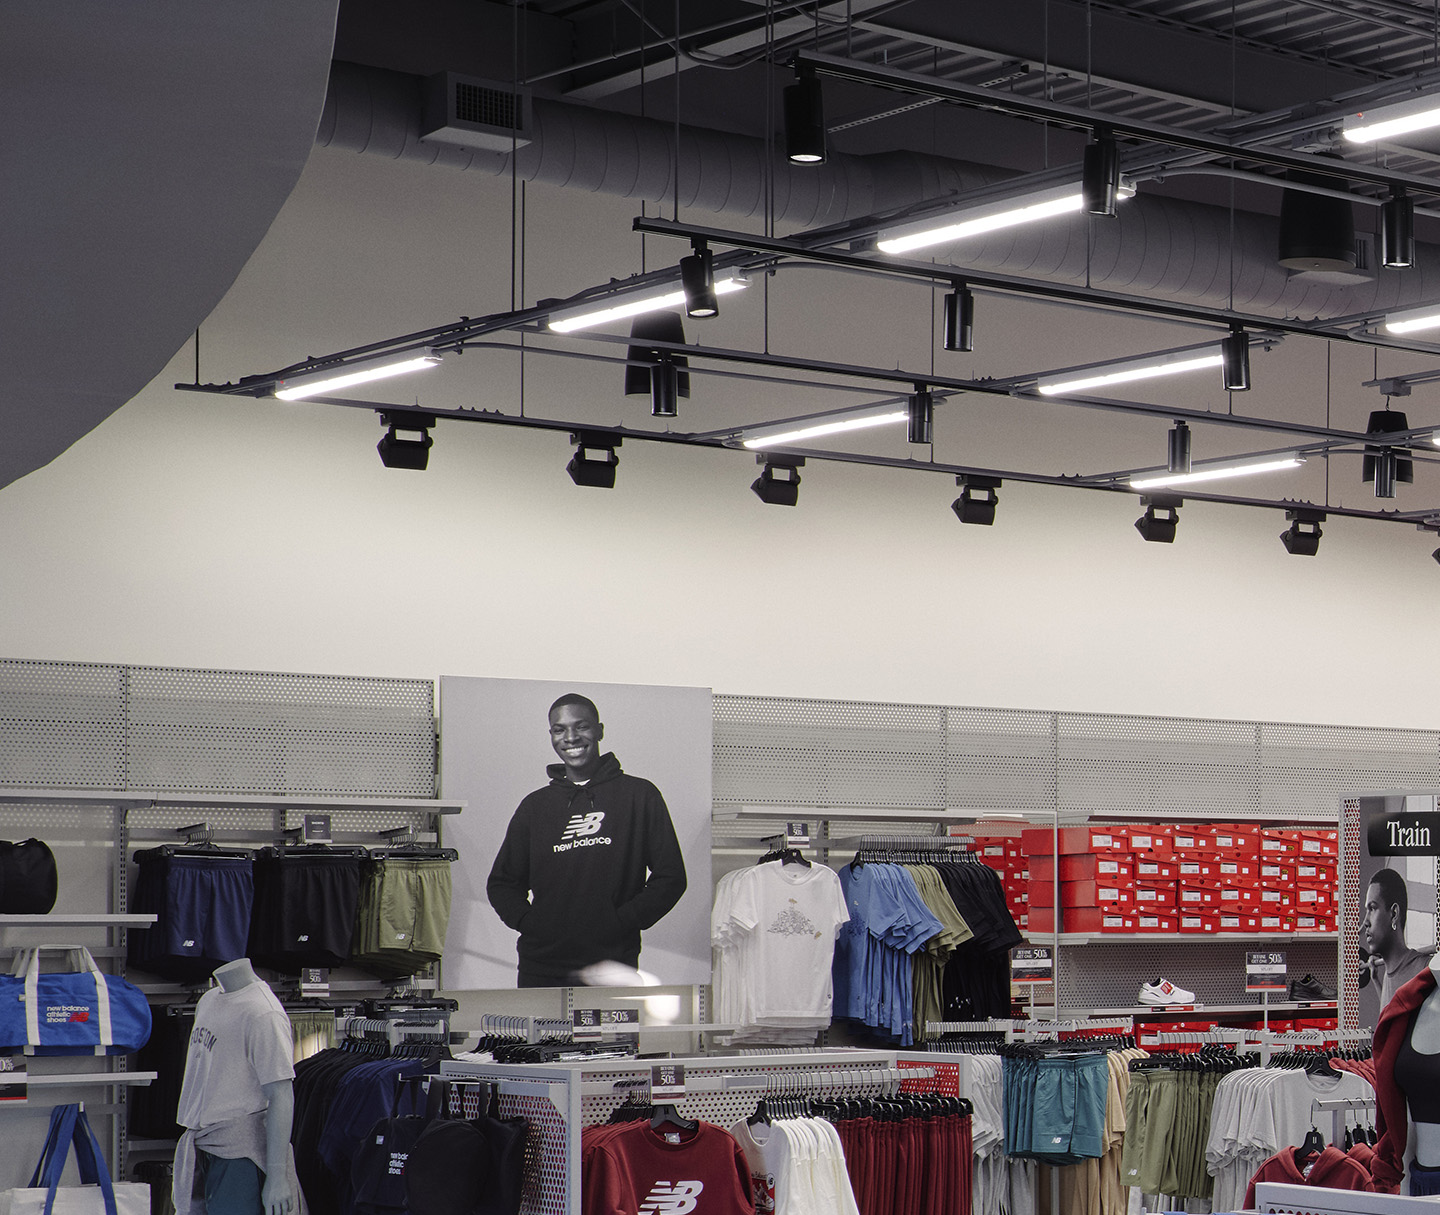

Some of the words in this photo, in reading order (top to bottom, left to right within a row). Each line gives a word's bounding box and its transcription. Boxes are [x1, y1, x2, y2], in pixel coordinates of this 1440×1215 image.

[560, 811, 606, 840] NB
[1387, 820, 1432, 848] Train
[552, 842, 573, 852] new
[573, 836, 612, 848] balance
[1268, 953, 1282, 964] 50%
[660, 1074, 675, 1085] 50%
